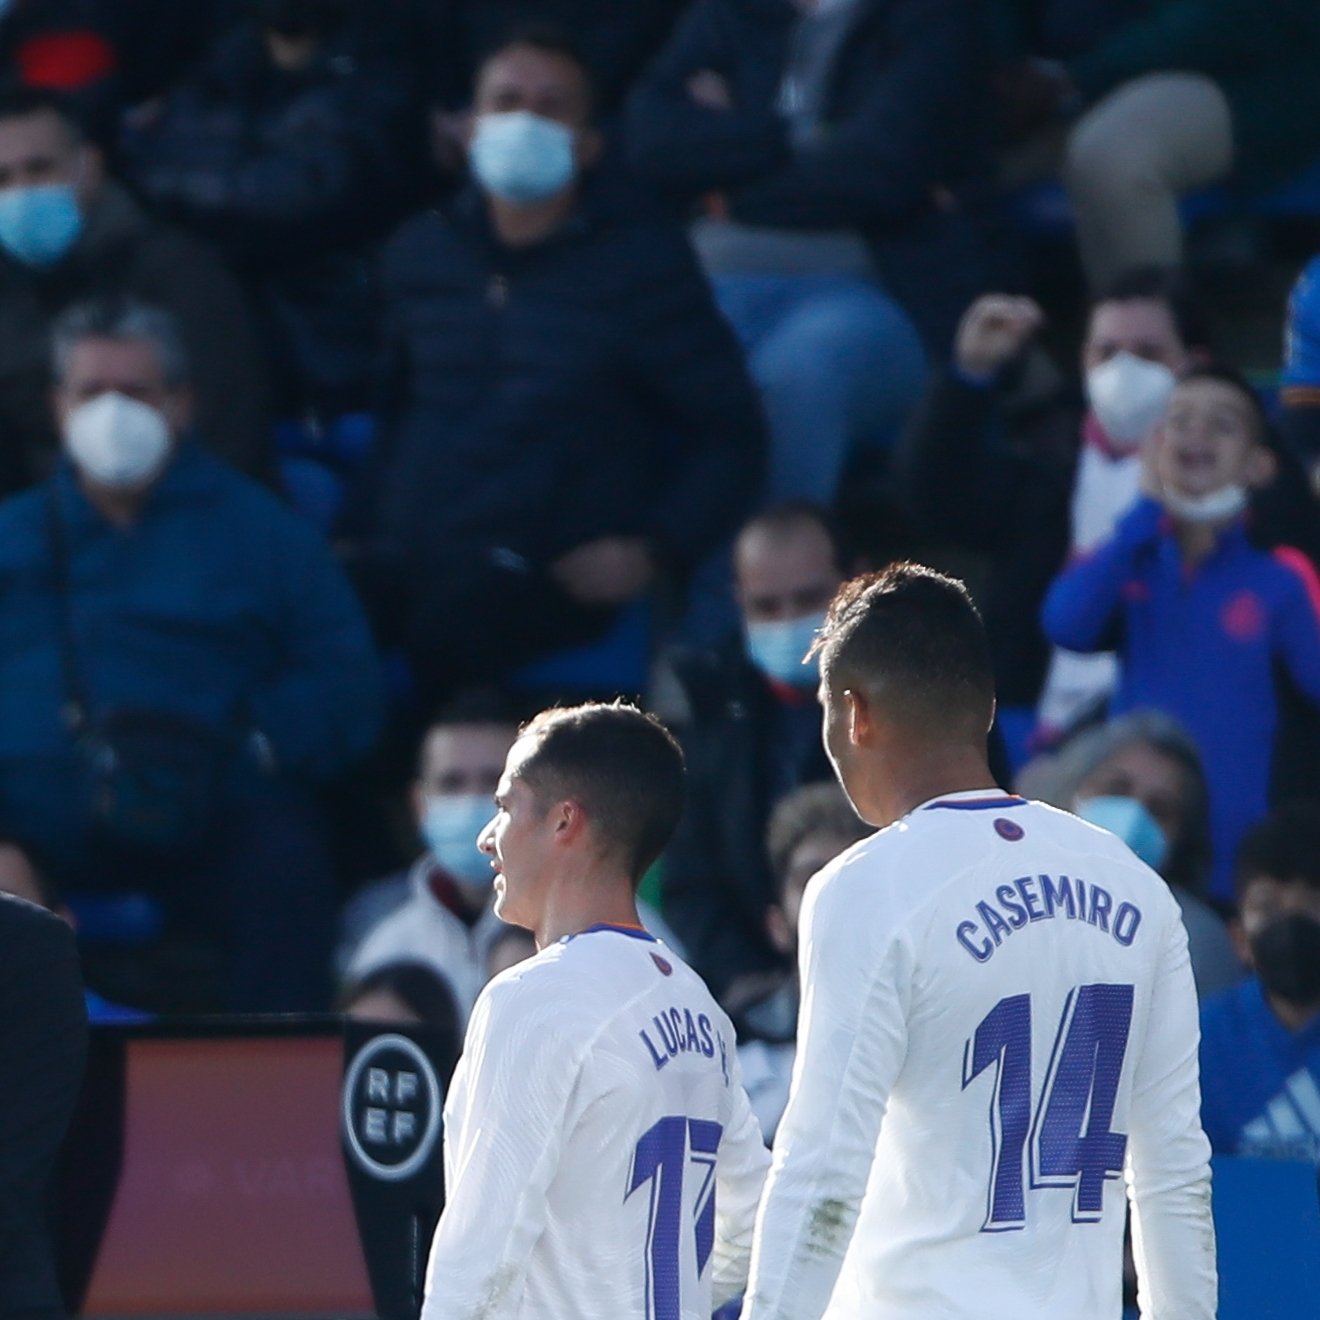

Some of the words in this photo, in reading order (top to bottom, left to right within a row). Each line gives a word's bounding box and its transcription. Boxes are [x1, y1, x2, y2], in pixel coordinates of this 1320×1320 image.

[956, 874, 1142, 963] CASEMIRO
[639, 1006, 714, 1072] LUCAS
[961, 983, 1135, 1233] 14
